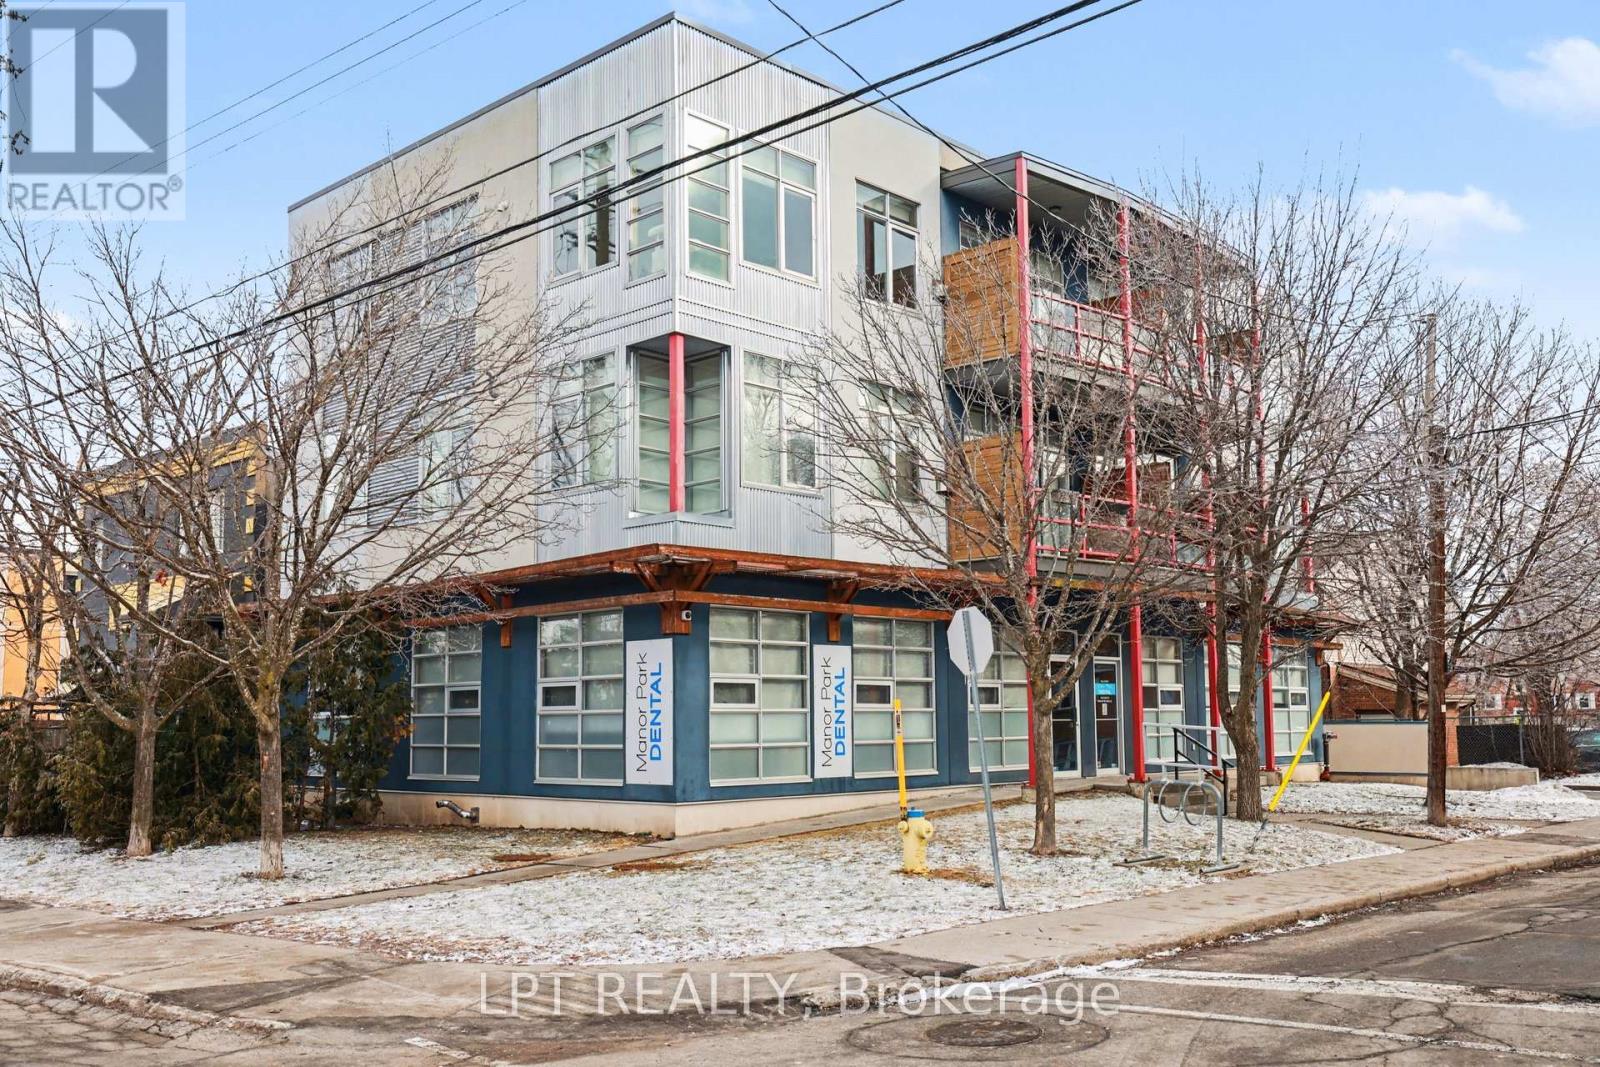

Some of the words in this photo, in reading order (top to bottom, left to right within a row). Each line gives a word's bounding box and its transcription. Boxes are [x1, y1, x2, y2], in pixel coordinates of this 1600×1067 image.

[636, 652, 647, 699] Park
[821, 656, 832, 700] Park
[636, 708, 647, 772] Manor
[649, 662, 662, 761] DENTAL
[821, 706, 832, 767] Manor
[834, 667, 846, 756] DENTAL
